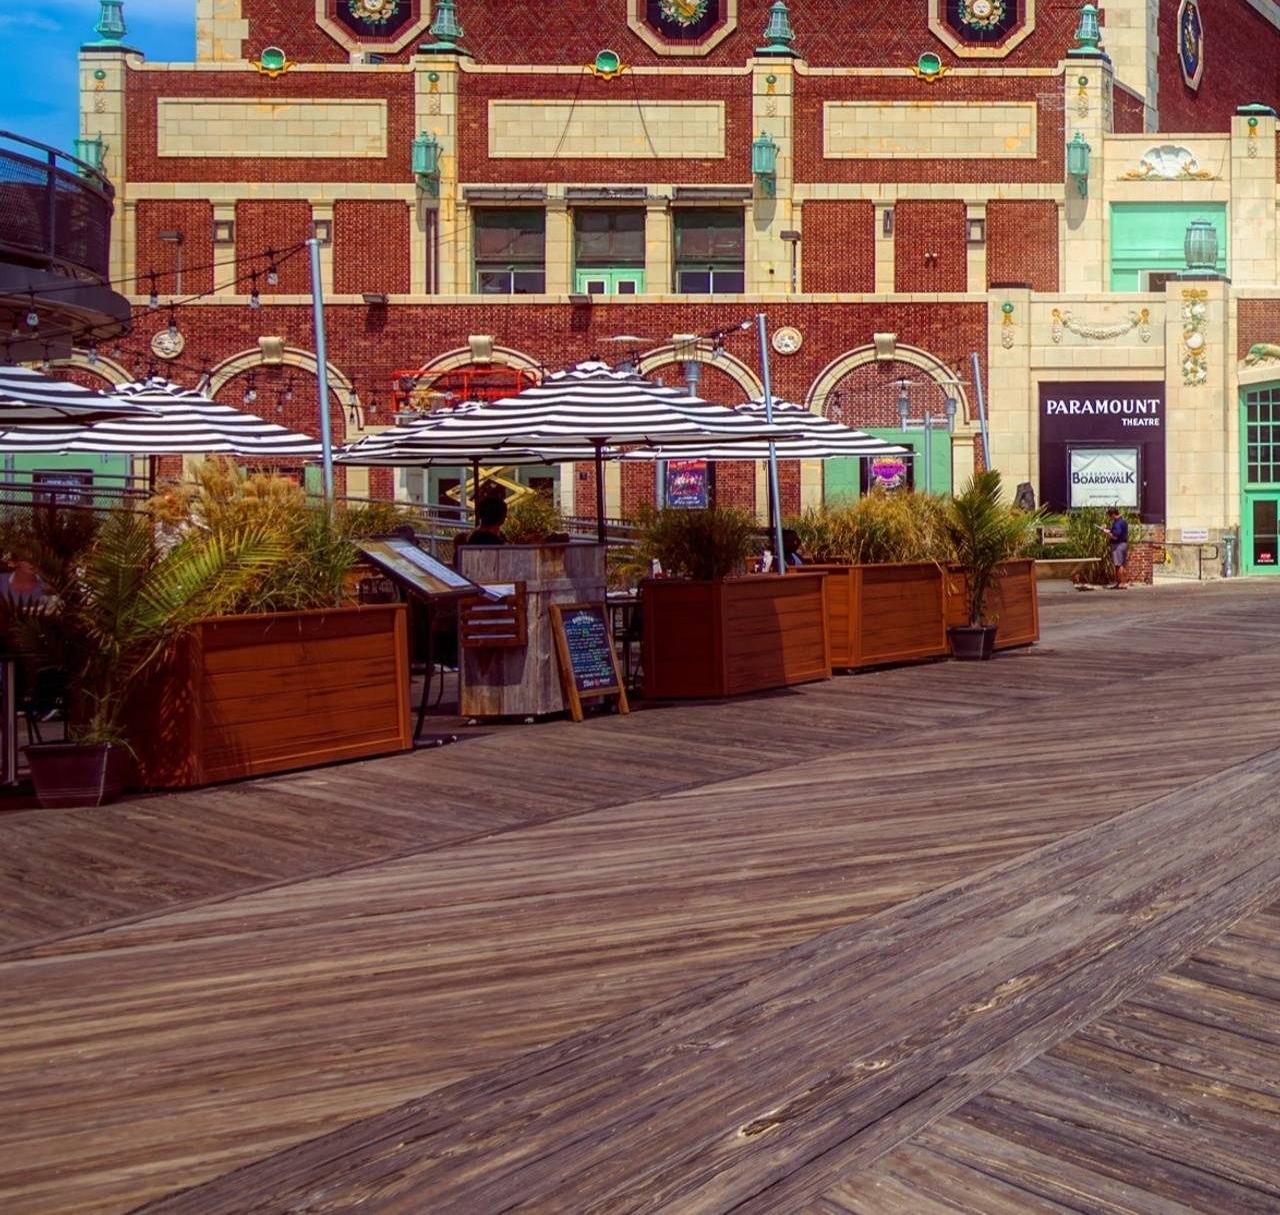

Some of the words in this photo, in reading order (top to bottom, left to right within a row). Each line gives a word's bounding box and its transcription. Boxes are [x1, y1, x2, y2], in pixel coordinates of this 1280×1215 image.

[1046, 400, 1160, 414] PARAMOUNT
[1121, 418, 1160, 426] THEATRE
[1072, 472, 1135, 484] BOARDWALK
